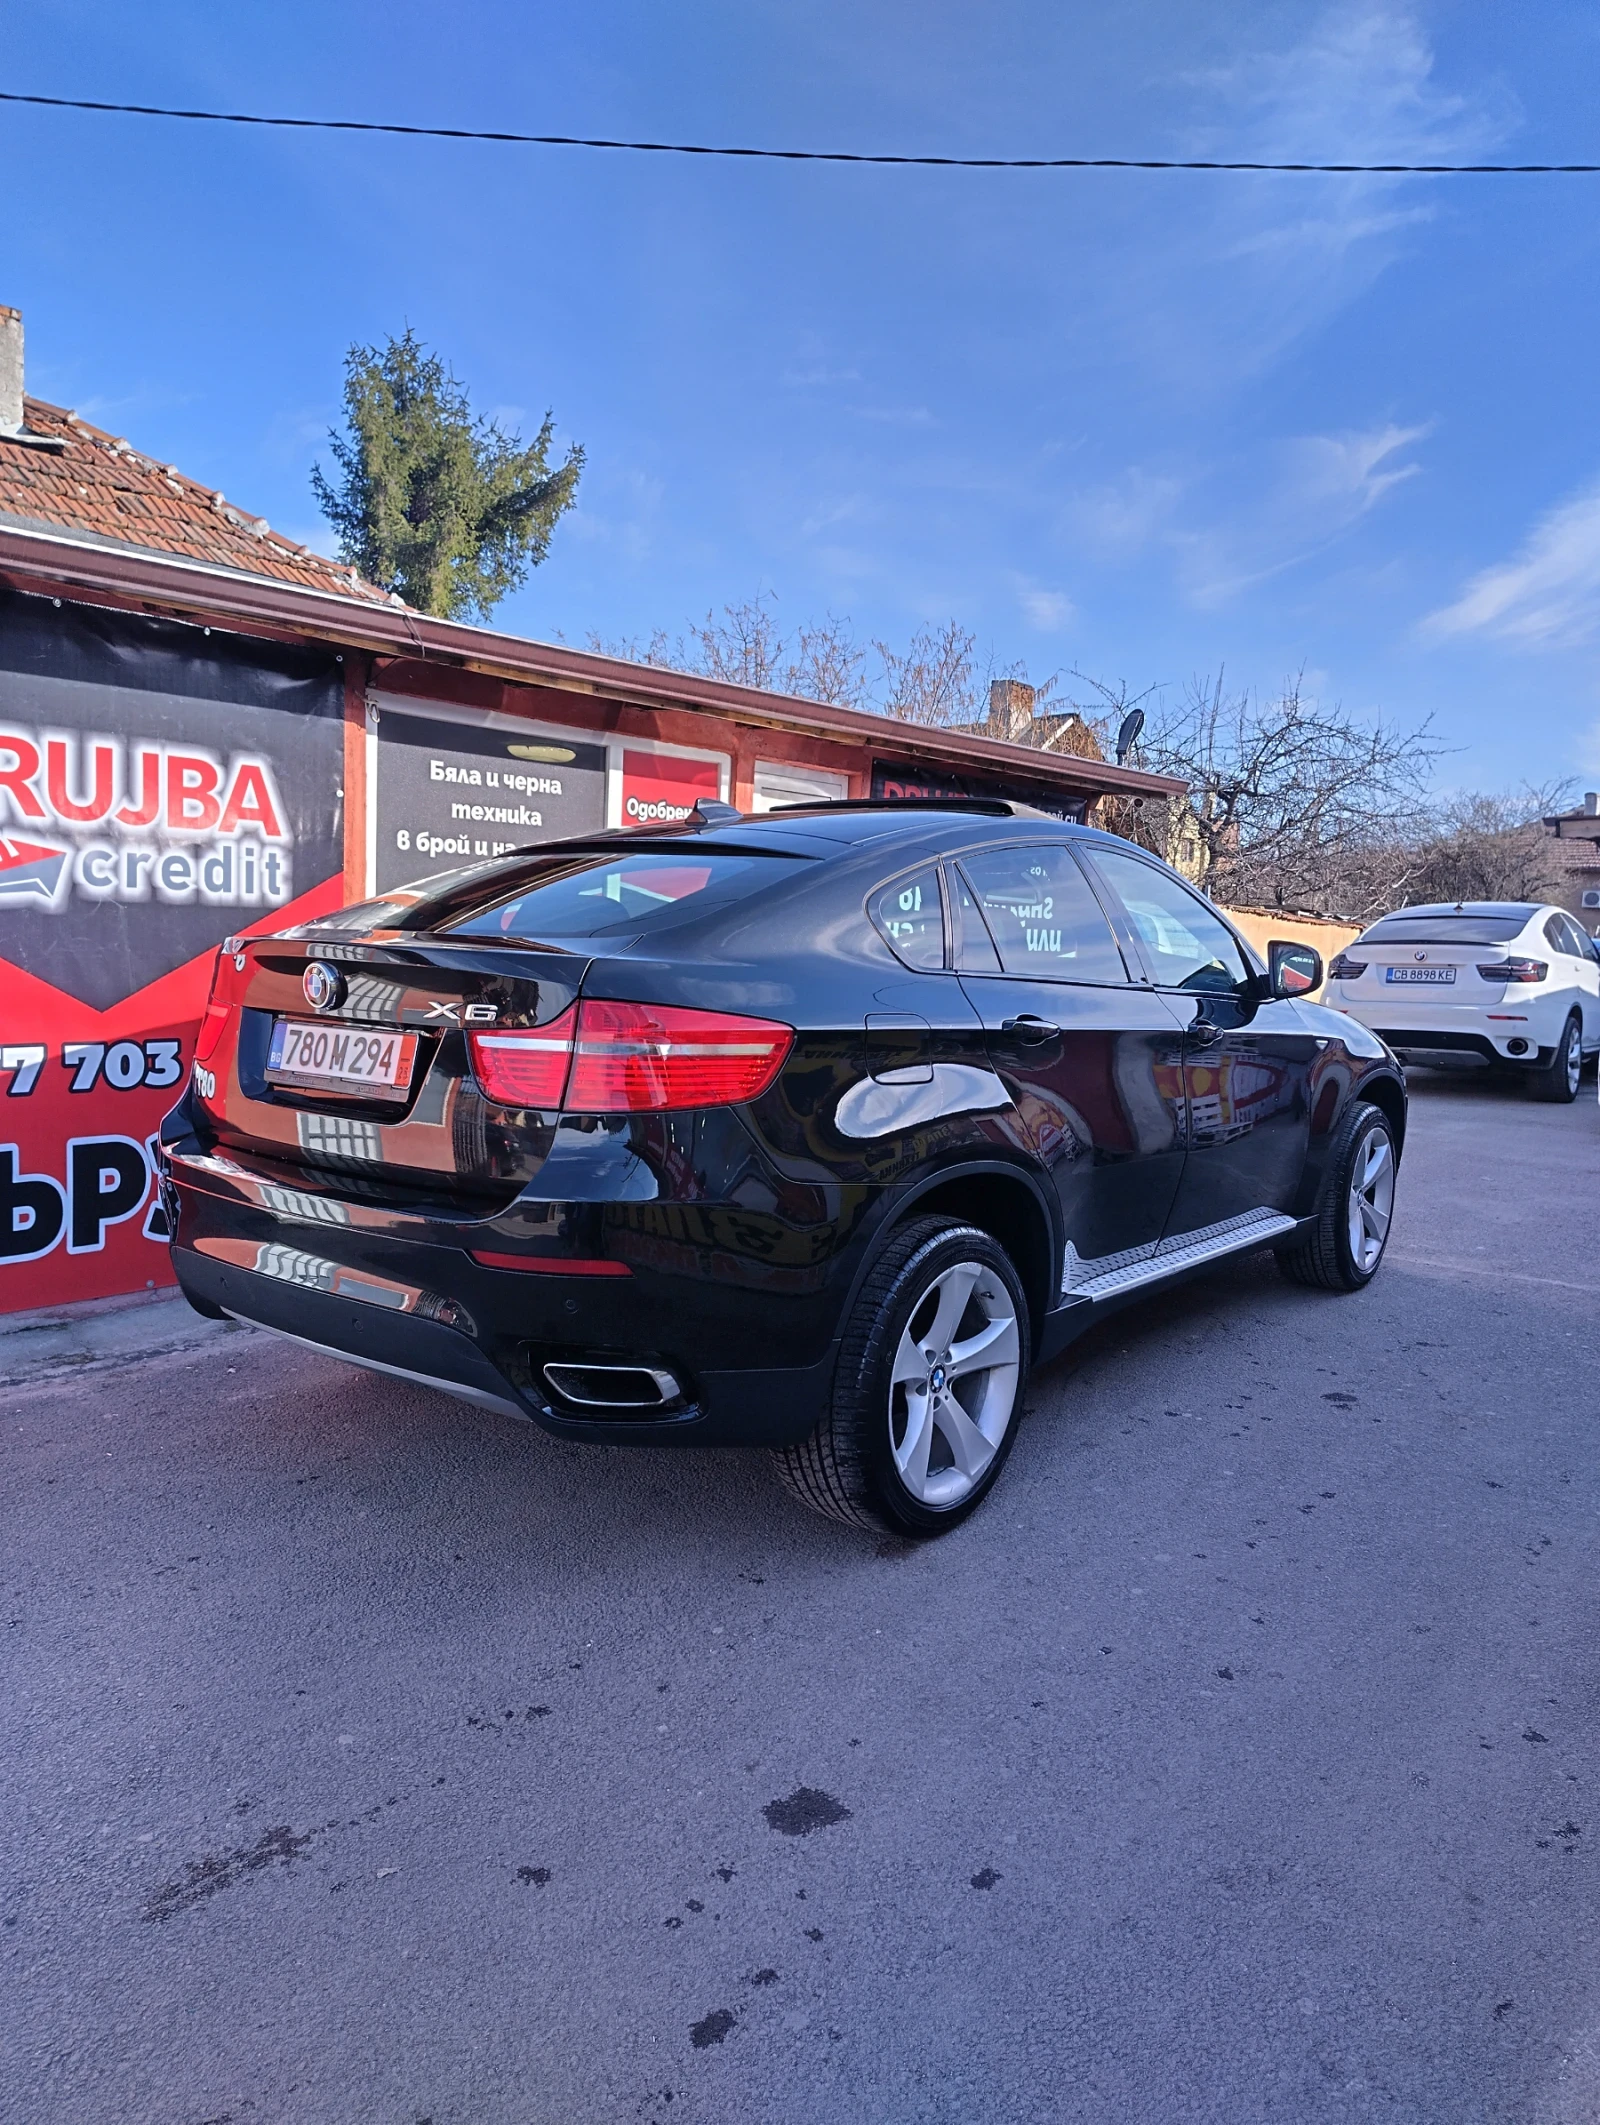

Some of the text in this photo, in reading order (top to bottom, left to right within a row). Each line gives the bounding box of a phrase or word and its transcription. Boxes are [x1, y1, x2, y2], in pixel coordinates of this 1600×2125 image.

[429, 759, 562, 796] Бяла и черна
[451, 802, 542, 826] техника
[396, 830, 411, 850] в
[416, 832, 470, 858] брой
[474, 840, 488, 856] и
[82, 846, 281, 895] credit
[1410, 969, 1437, 980] 8898
[1437, 970, 1453, 981] KE
[423, 1001, 498, 1021] X6
[64, 1041, 182, 1091] 703
[270, 1051, 281, 1063] BG
